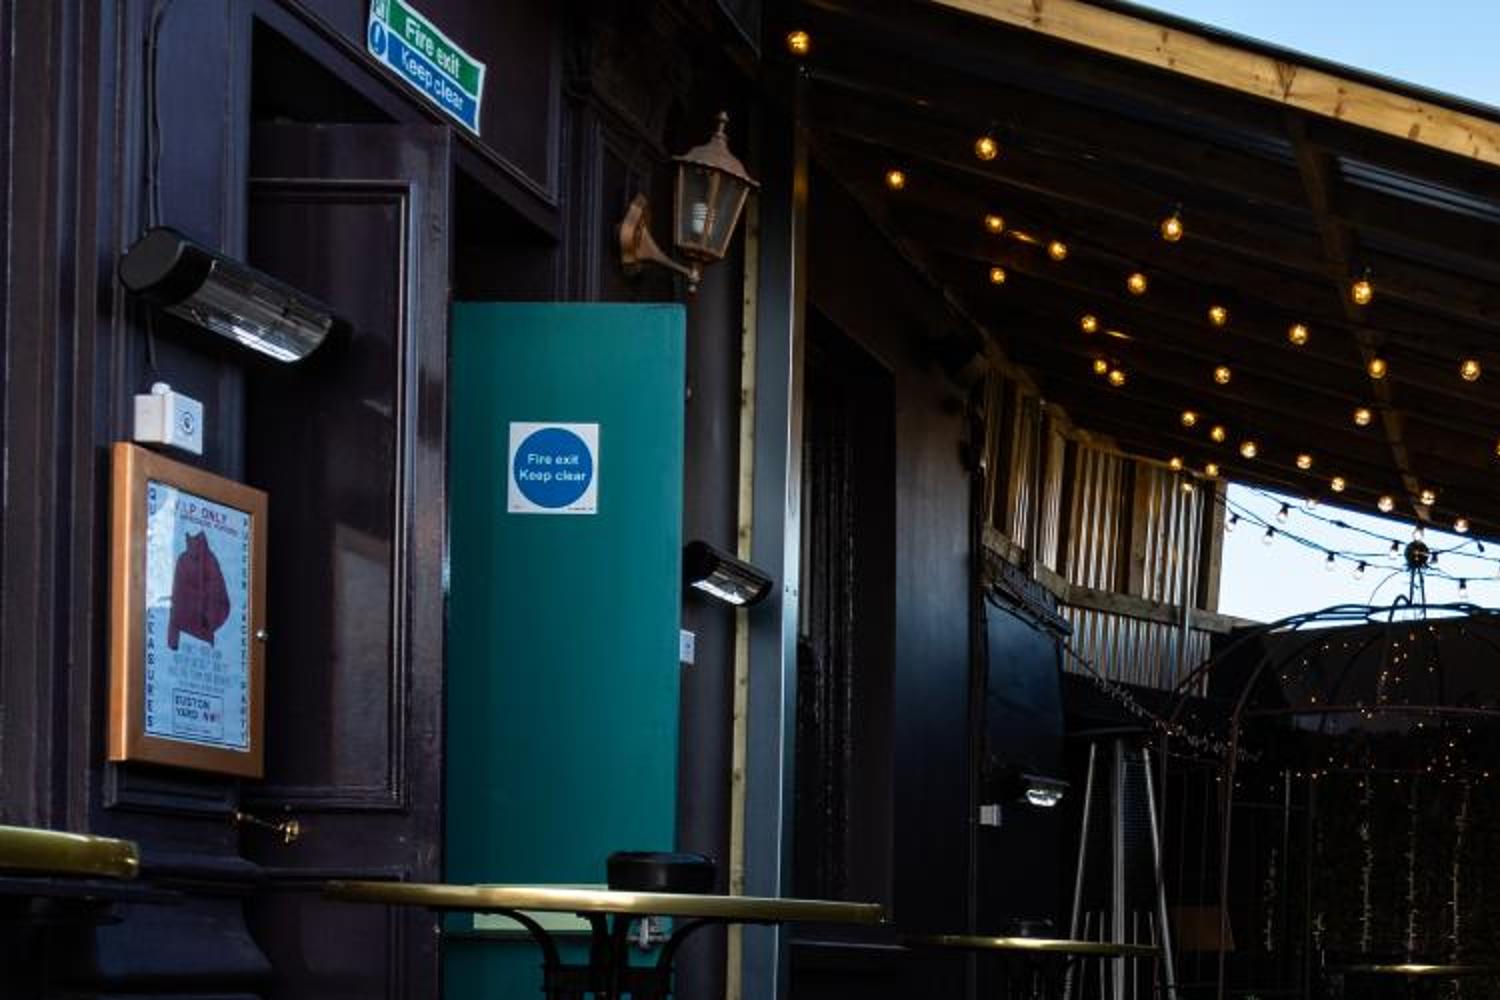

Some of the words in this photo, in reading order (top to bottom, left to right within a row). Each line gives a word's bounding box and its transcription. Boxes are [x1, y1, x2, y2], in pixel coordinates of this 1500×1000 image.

[405, 17, 434, 56] Fire
[436, 47, 460, 78] exit
[401, 46, 432, 89] Keep
[434, 79, 464, 110] clear
[519, 469, 552, 483] Keep
[555, 469, 586, 481] clear
[527, 453, 552, 465] Fire
[555, 454, 580, 465] exit
